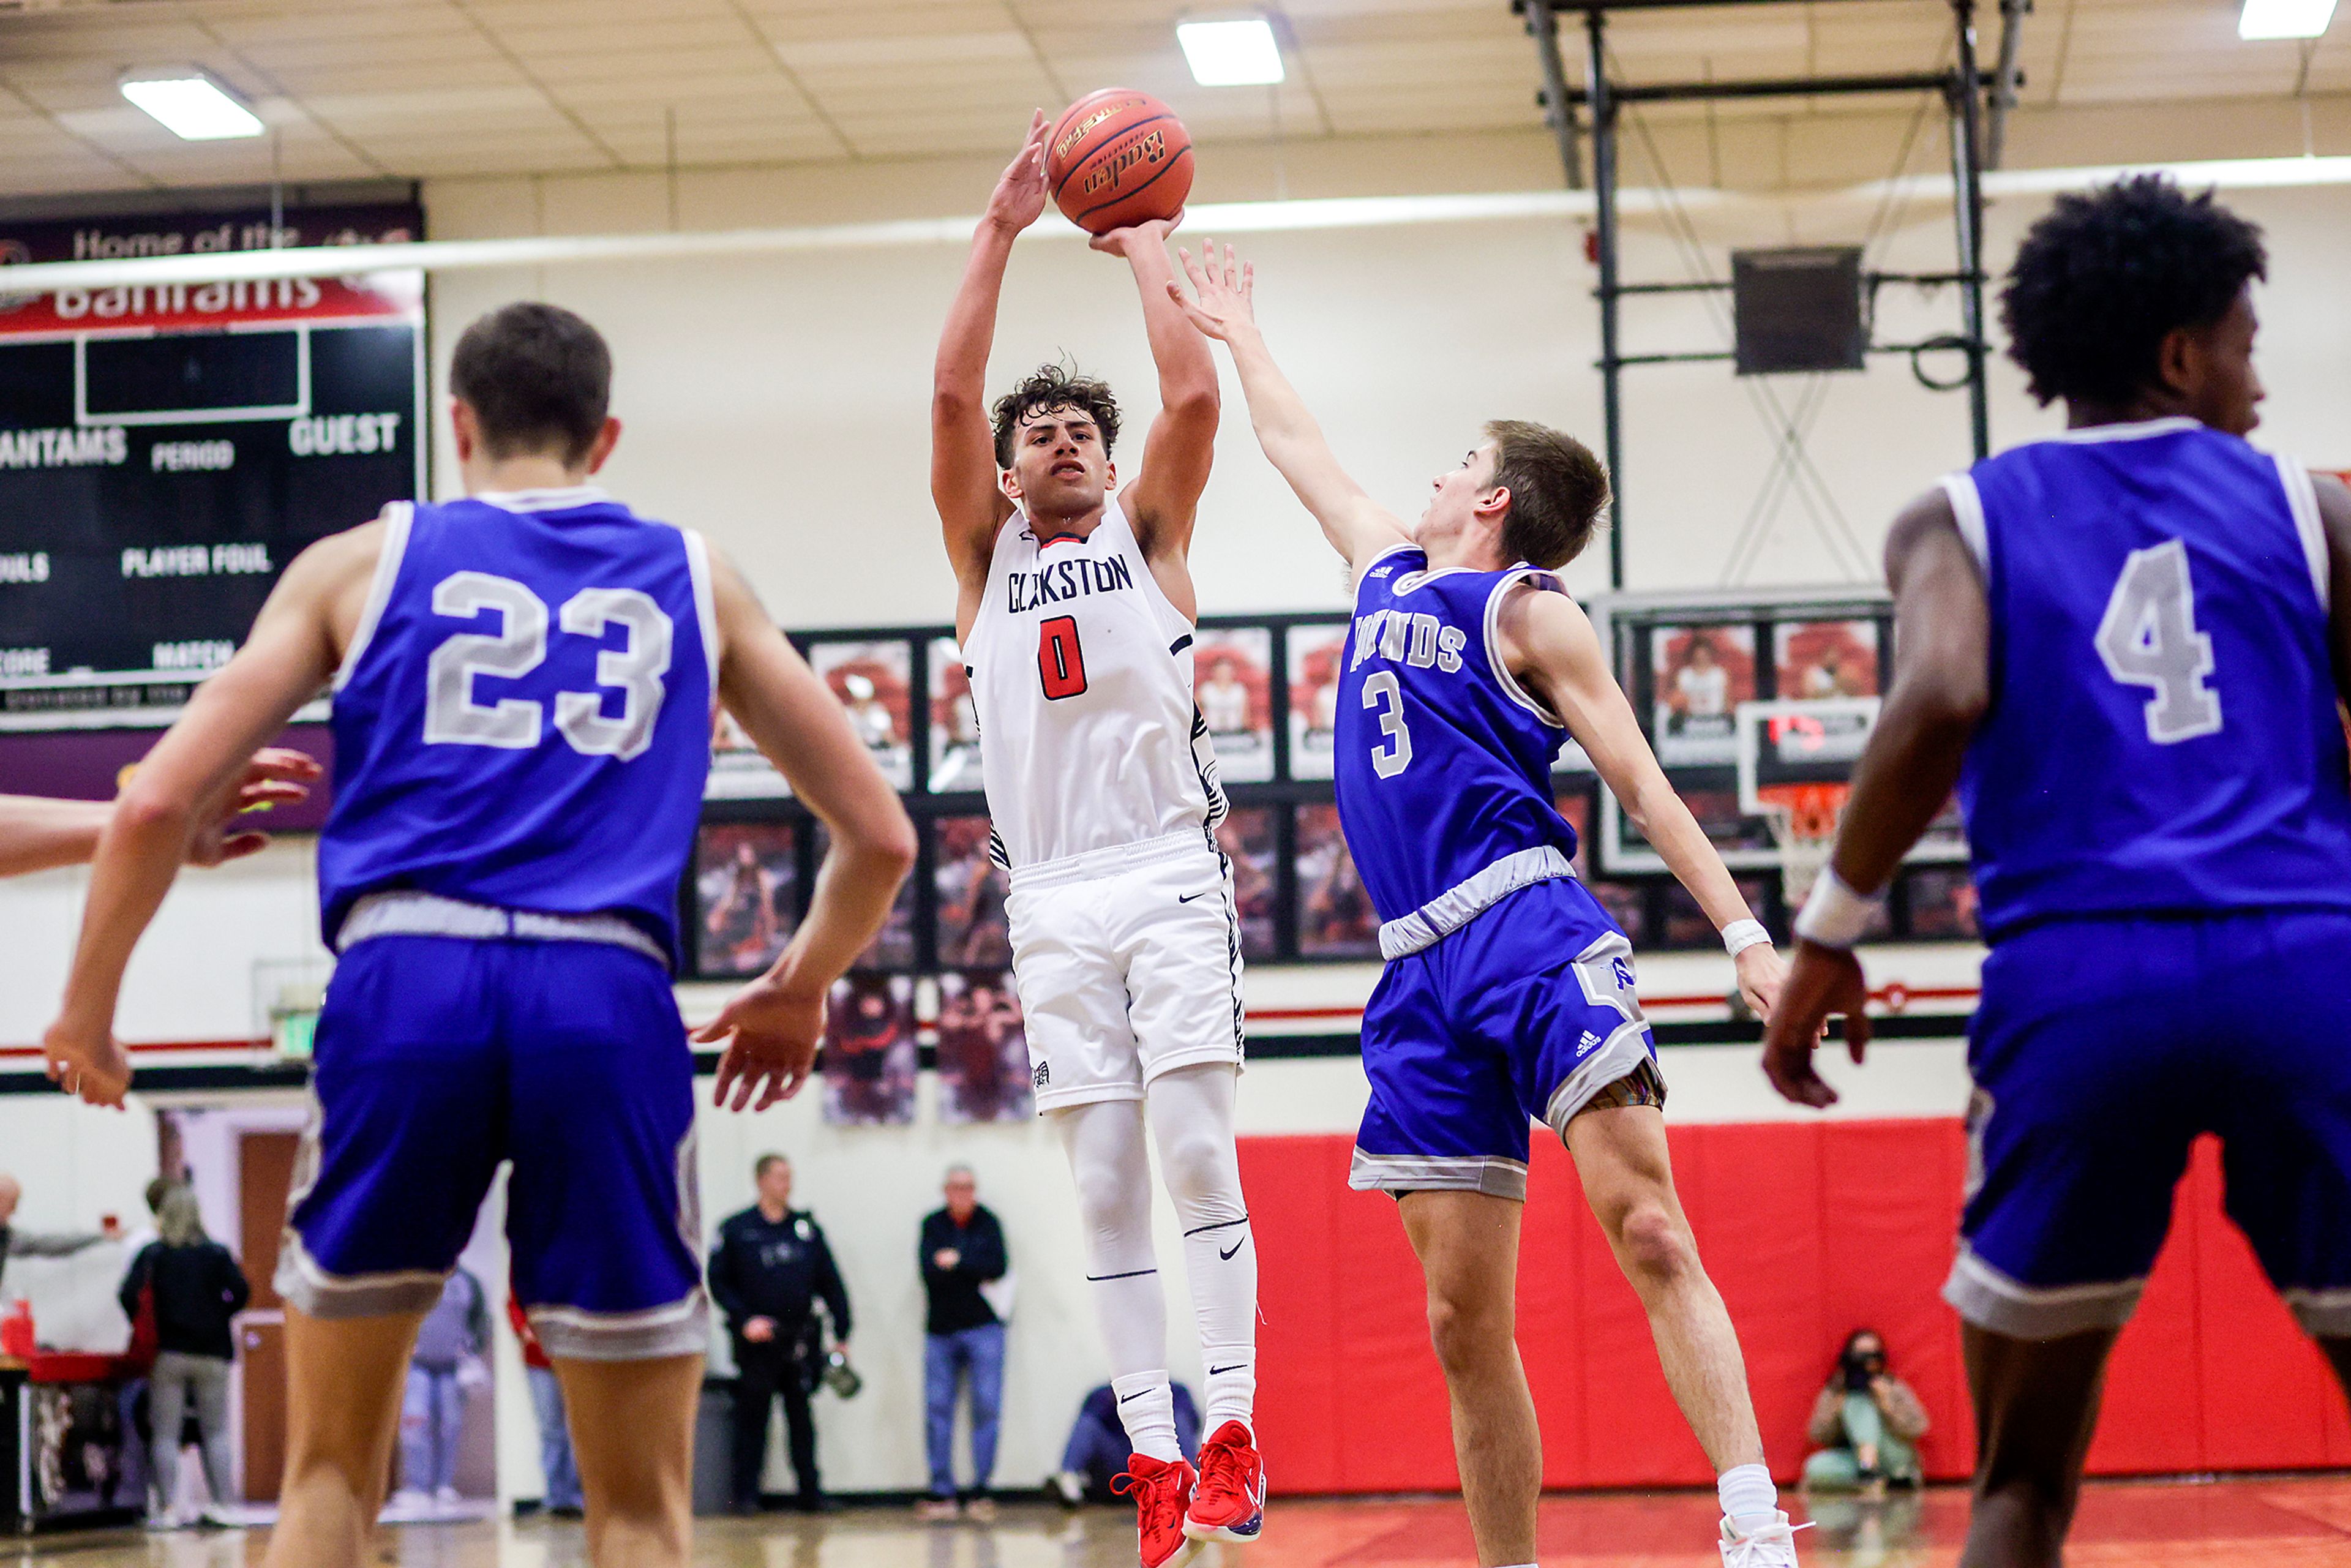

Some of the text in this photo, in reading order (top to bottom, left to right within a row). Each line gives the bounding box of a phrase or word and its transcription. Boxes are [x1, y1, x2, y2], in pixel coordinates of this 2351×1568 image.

[1084, 130, 1164, 195] Baden
[0, 427, 127, 468] ANTAMS
[288, 413, 400, 456] GUEST
[122, 543, 274, 578] PLAYER FOUL
[1007, 553, 1134, 614] CLKSTON
[422, 571, 672, 762] 23
[1037, 614, 1088, 701] 0
[2094, 536, 2224, 745] 4
[1361, 670, 1413, 780] 3
[1576, 1035, 1602, 1057] adidas
